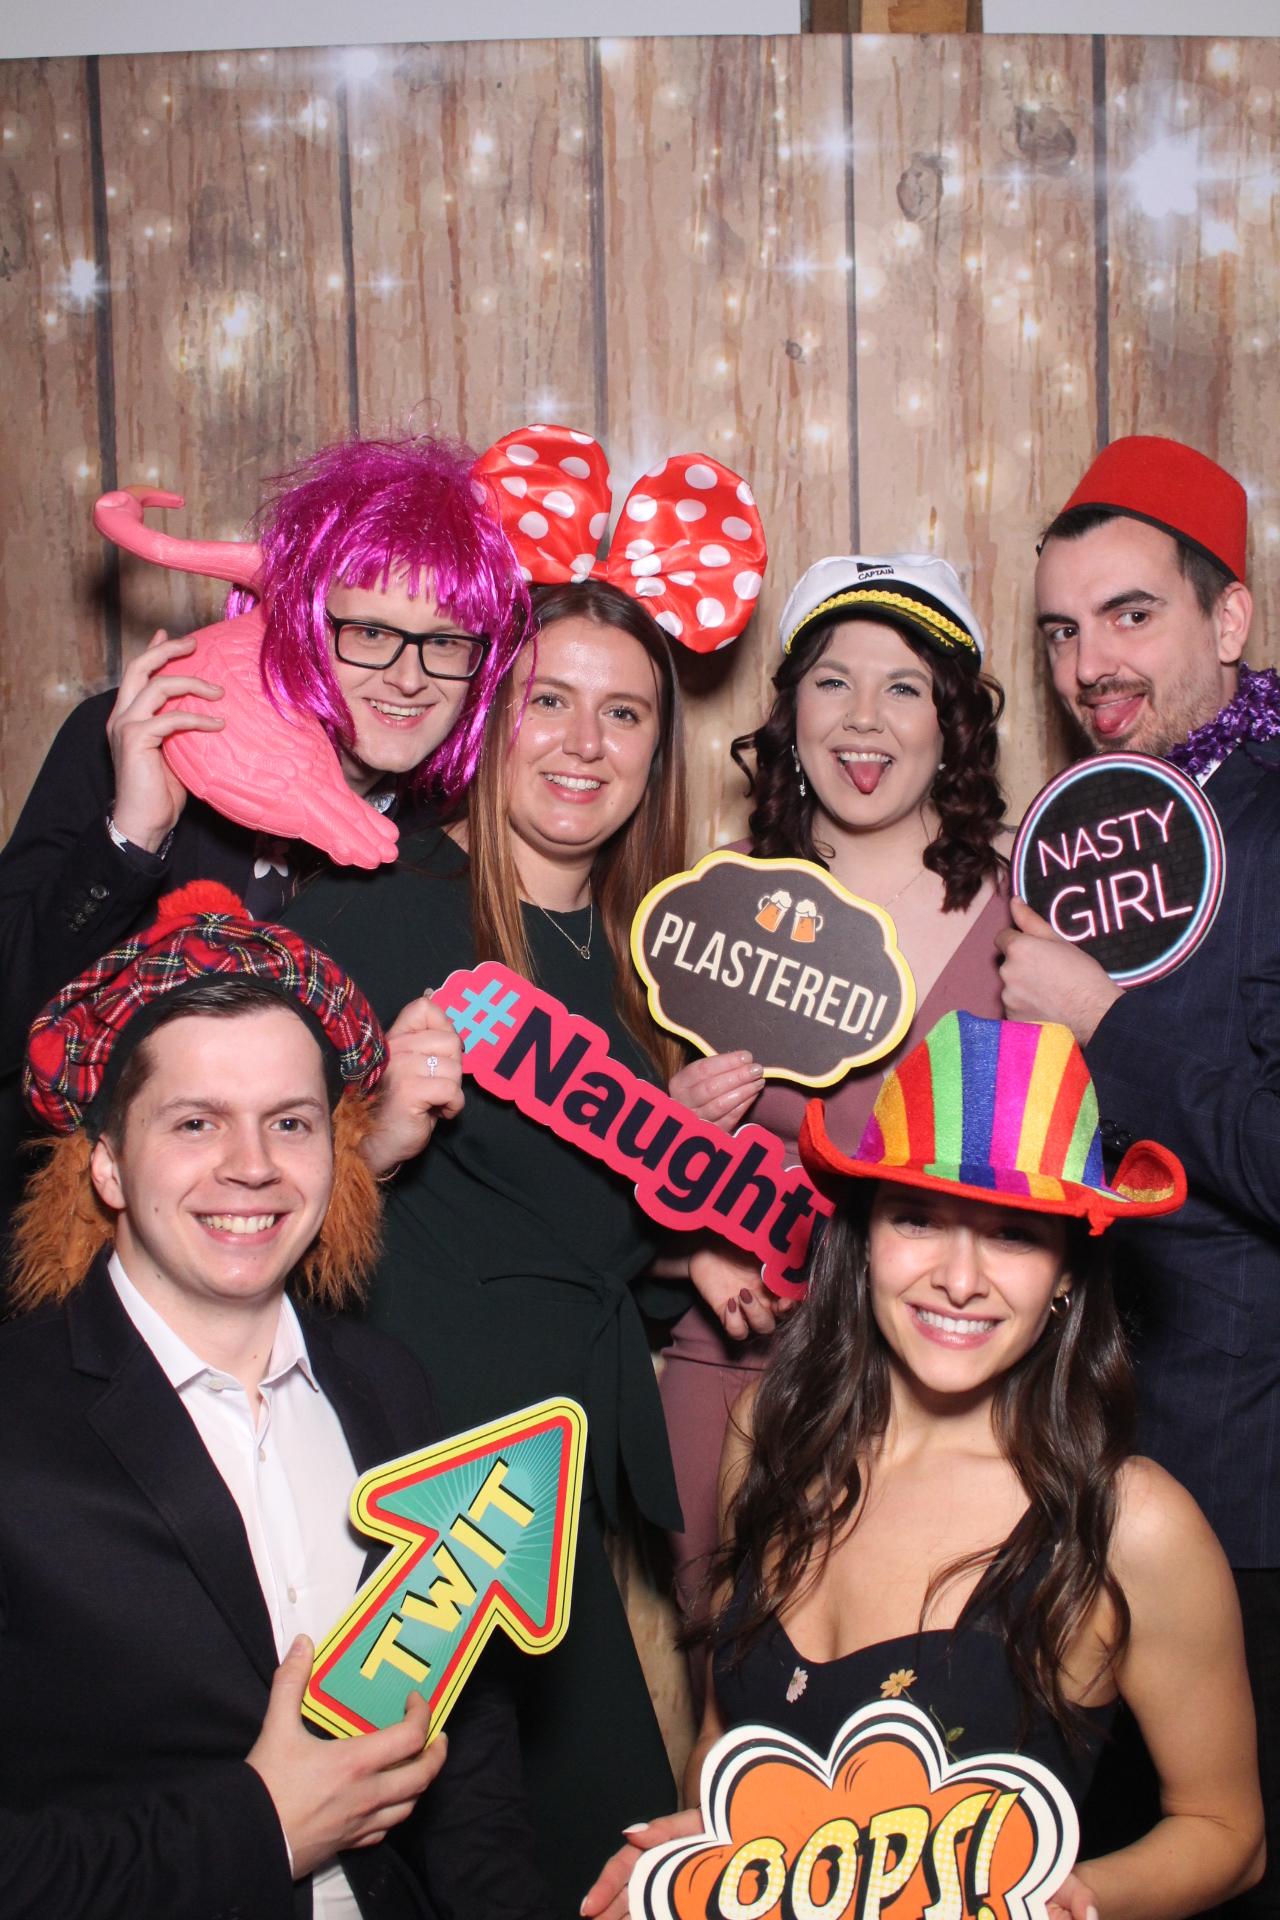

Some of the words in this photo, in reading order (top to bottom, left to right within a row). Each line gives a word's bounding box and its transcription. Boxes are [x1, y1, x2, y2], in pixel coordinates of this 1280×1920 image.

[858, 567, 895, 581] CAPTAIN
[1037, 800, 1175, 877] NASTY
[1050, 863, 1194, 942] GIRL
[650, 912, 888, 1041] PLASTERED!
[359, 1456, 535, 1684] TWIT
[712, 1789, 1026, 1920] OOPS!
